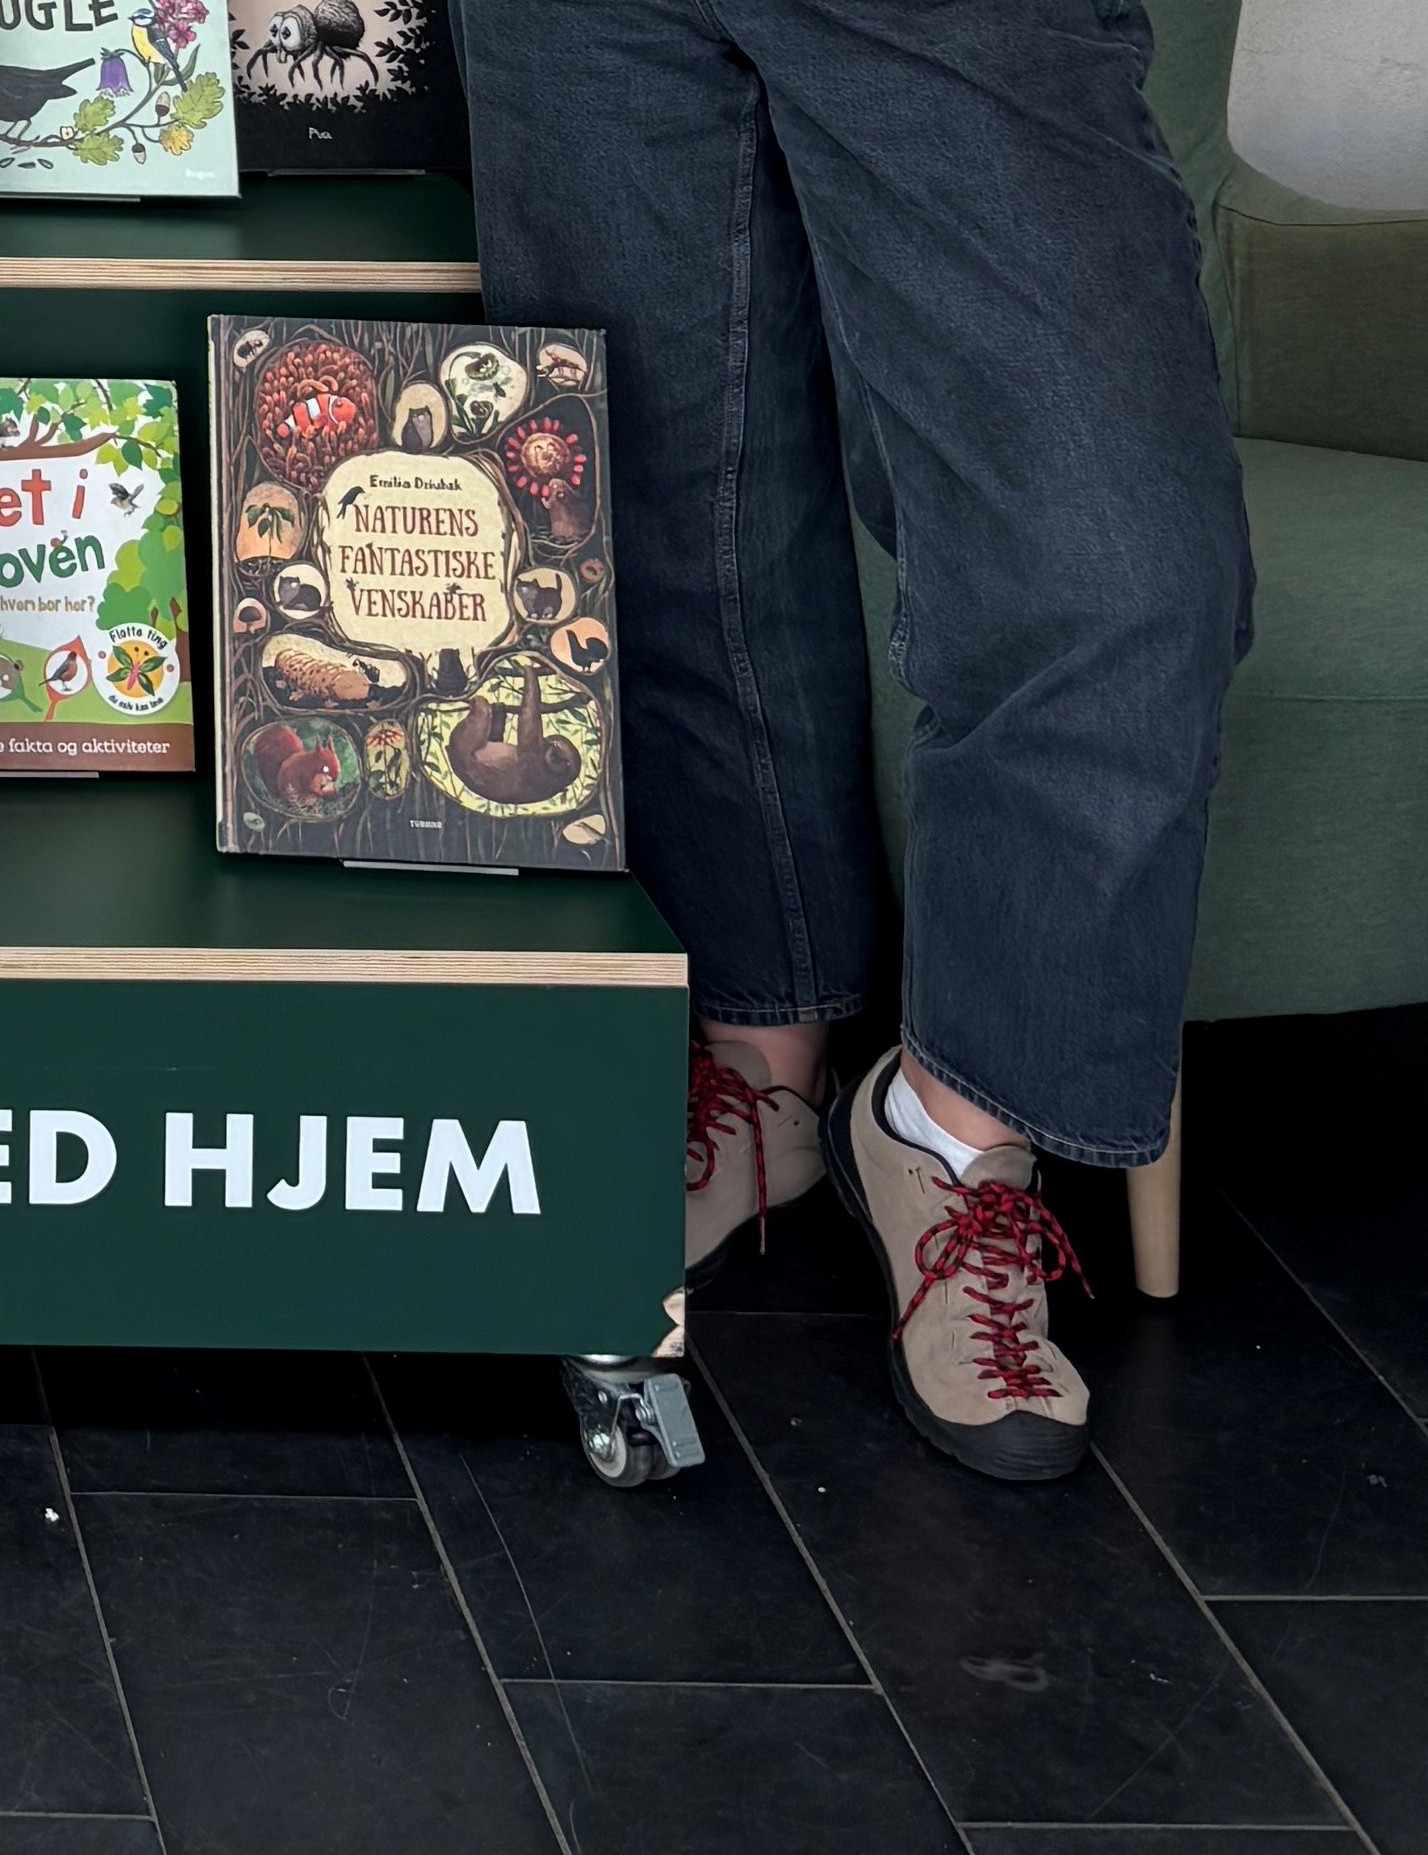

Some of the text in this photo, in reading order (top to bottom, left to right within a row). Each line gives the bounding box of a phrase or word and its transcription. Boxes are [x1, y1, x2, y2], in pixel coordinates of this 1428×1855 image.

[72, 468, 88, 520] i
[369, 475, 412, 489] Emilia
[355, 505, 480, 538] NATURENS
[340, 544, 496, 580] FANTASTISKE
[0, 596, 35, 612] hvem
[38, 596, 61, 612] bor
[350, 588, 488, 622] VENSKABER
[147, 629, 168, 650] ting
[9, 738, 53, 754] fakta
[57, 742, 78, 756] og
[82, 738, 170, 755] aktiviteter
[165, 1113, 540, 1214] HJEM
